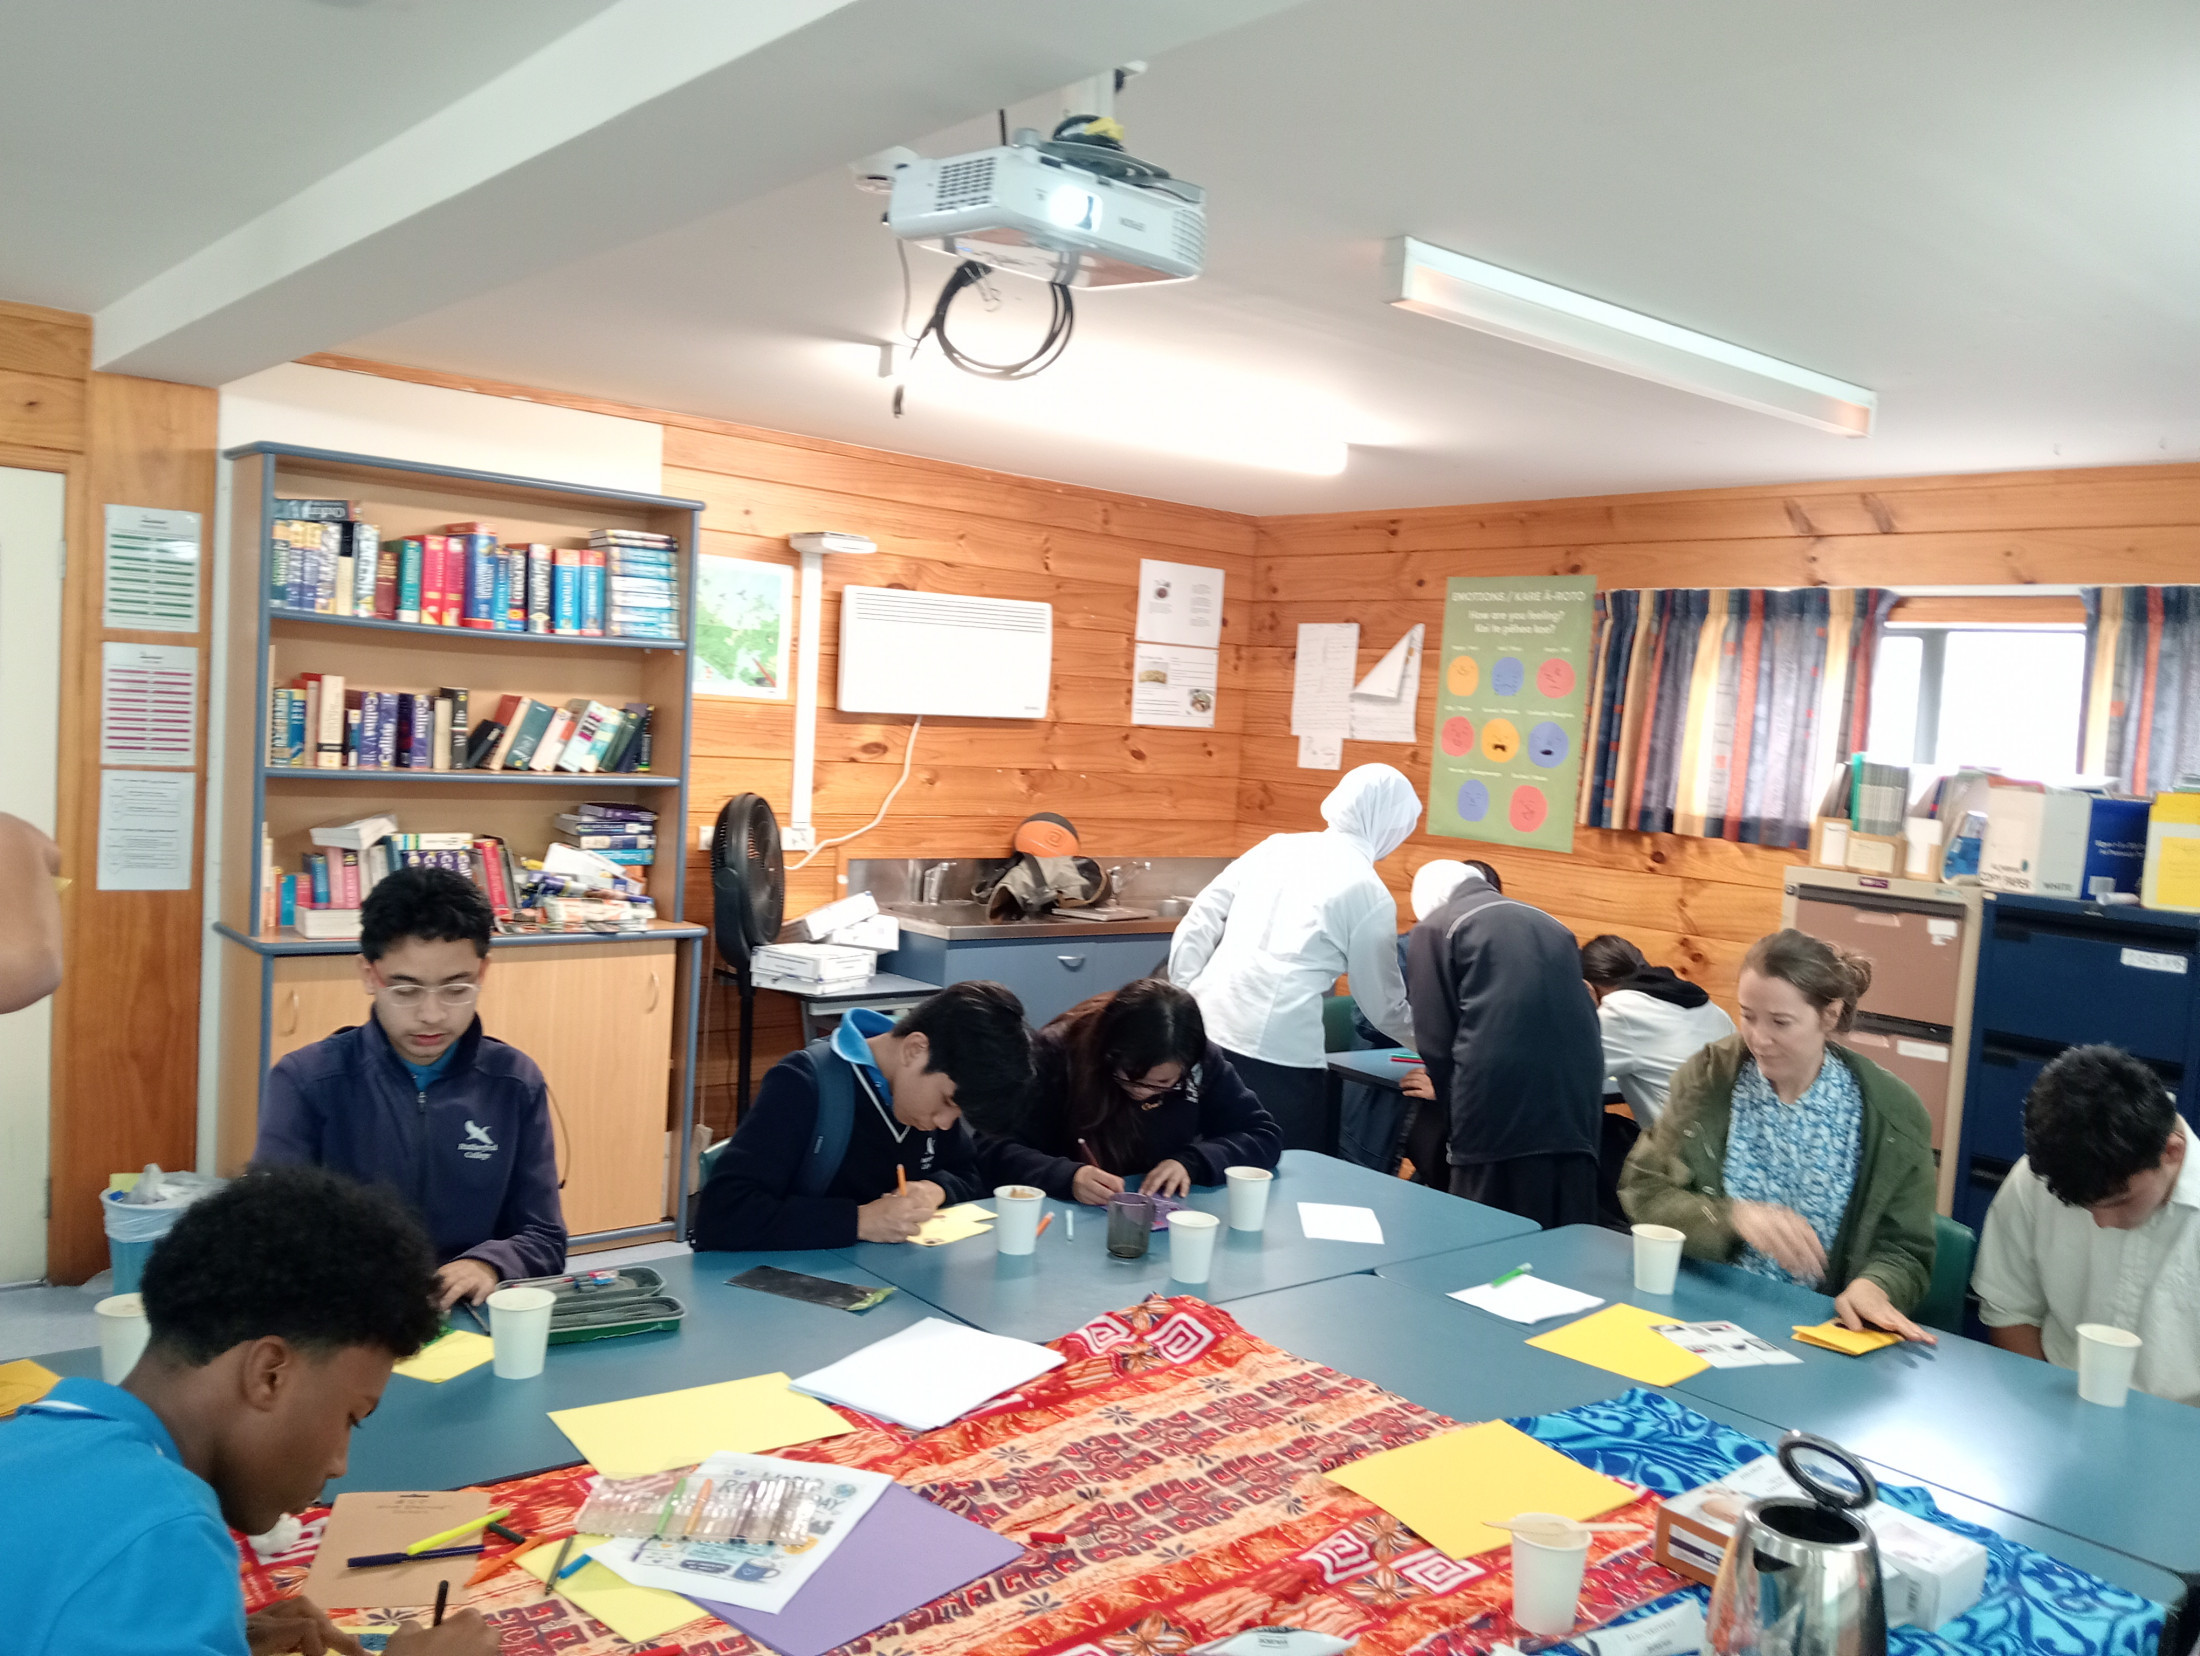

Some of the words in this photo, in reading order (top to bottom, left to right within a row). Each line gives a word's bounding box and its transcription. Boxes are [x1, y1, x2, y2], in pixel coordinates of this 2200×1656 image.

[511, 555, 526, 600] OXFORD
[1451, 591, 1506, 602] EMOTIONS
[1468, 610, 1489, 620] How
[1490, 612, 1507, 620] are
[1508, 612, 1526, 623] you
[363, 696, 379, 737] Collins
[415, 699, 430, 739] Collins
